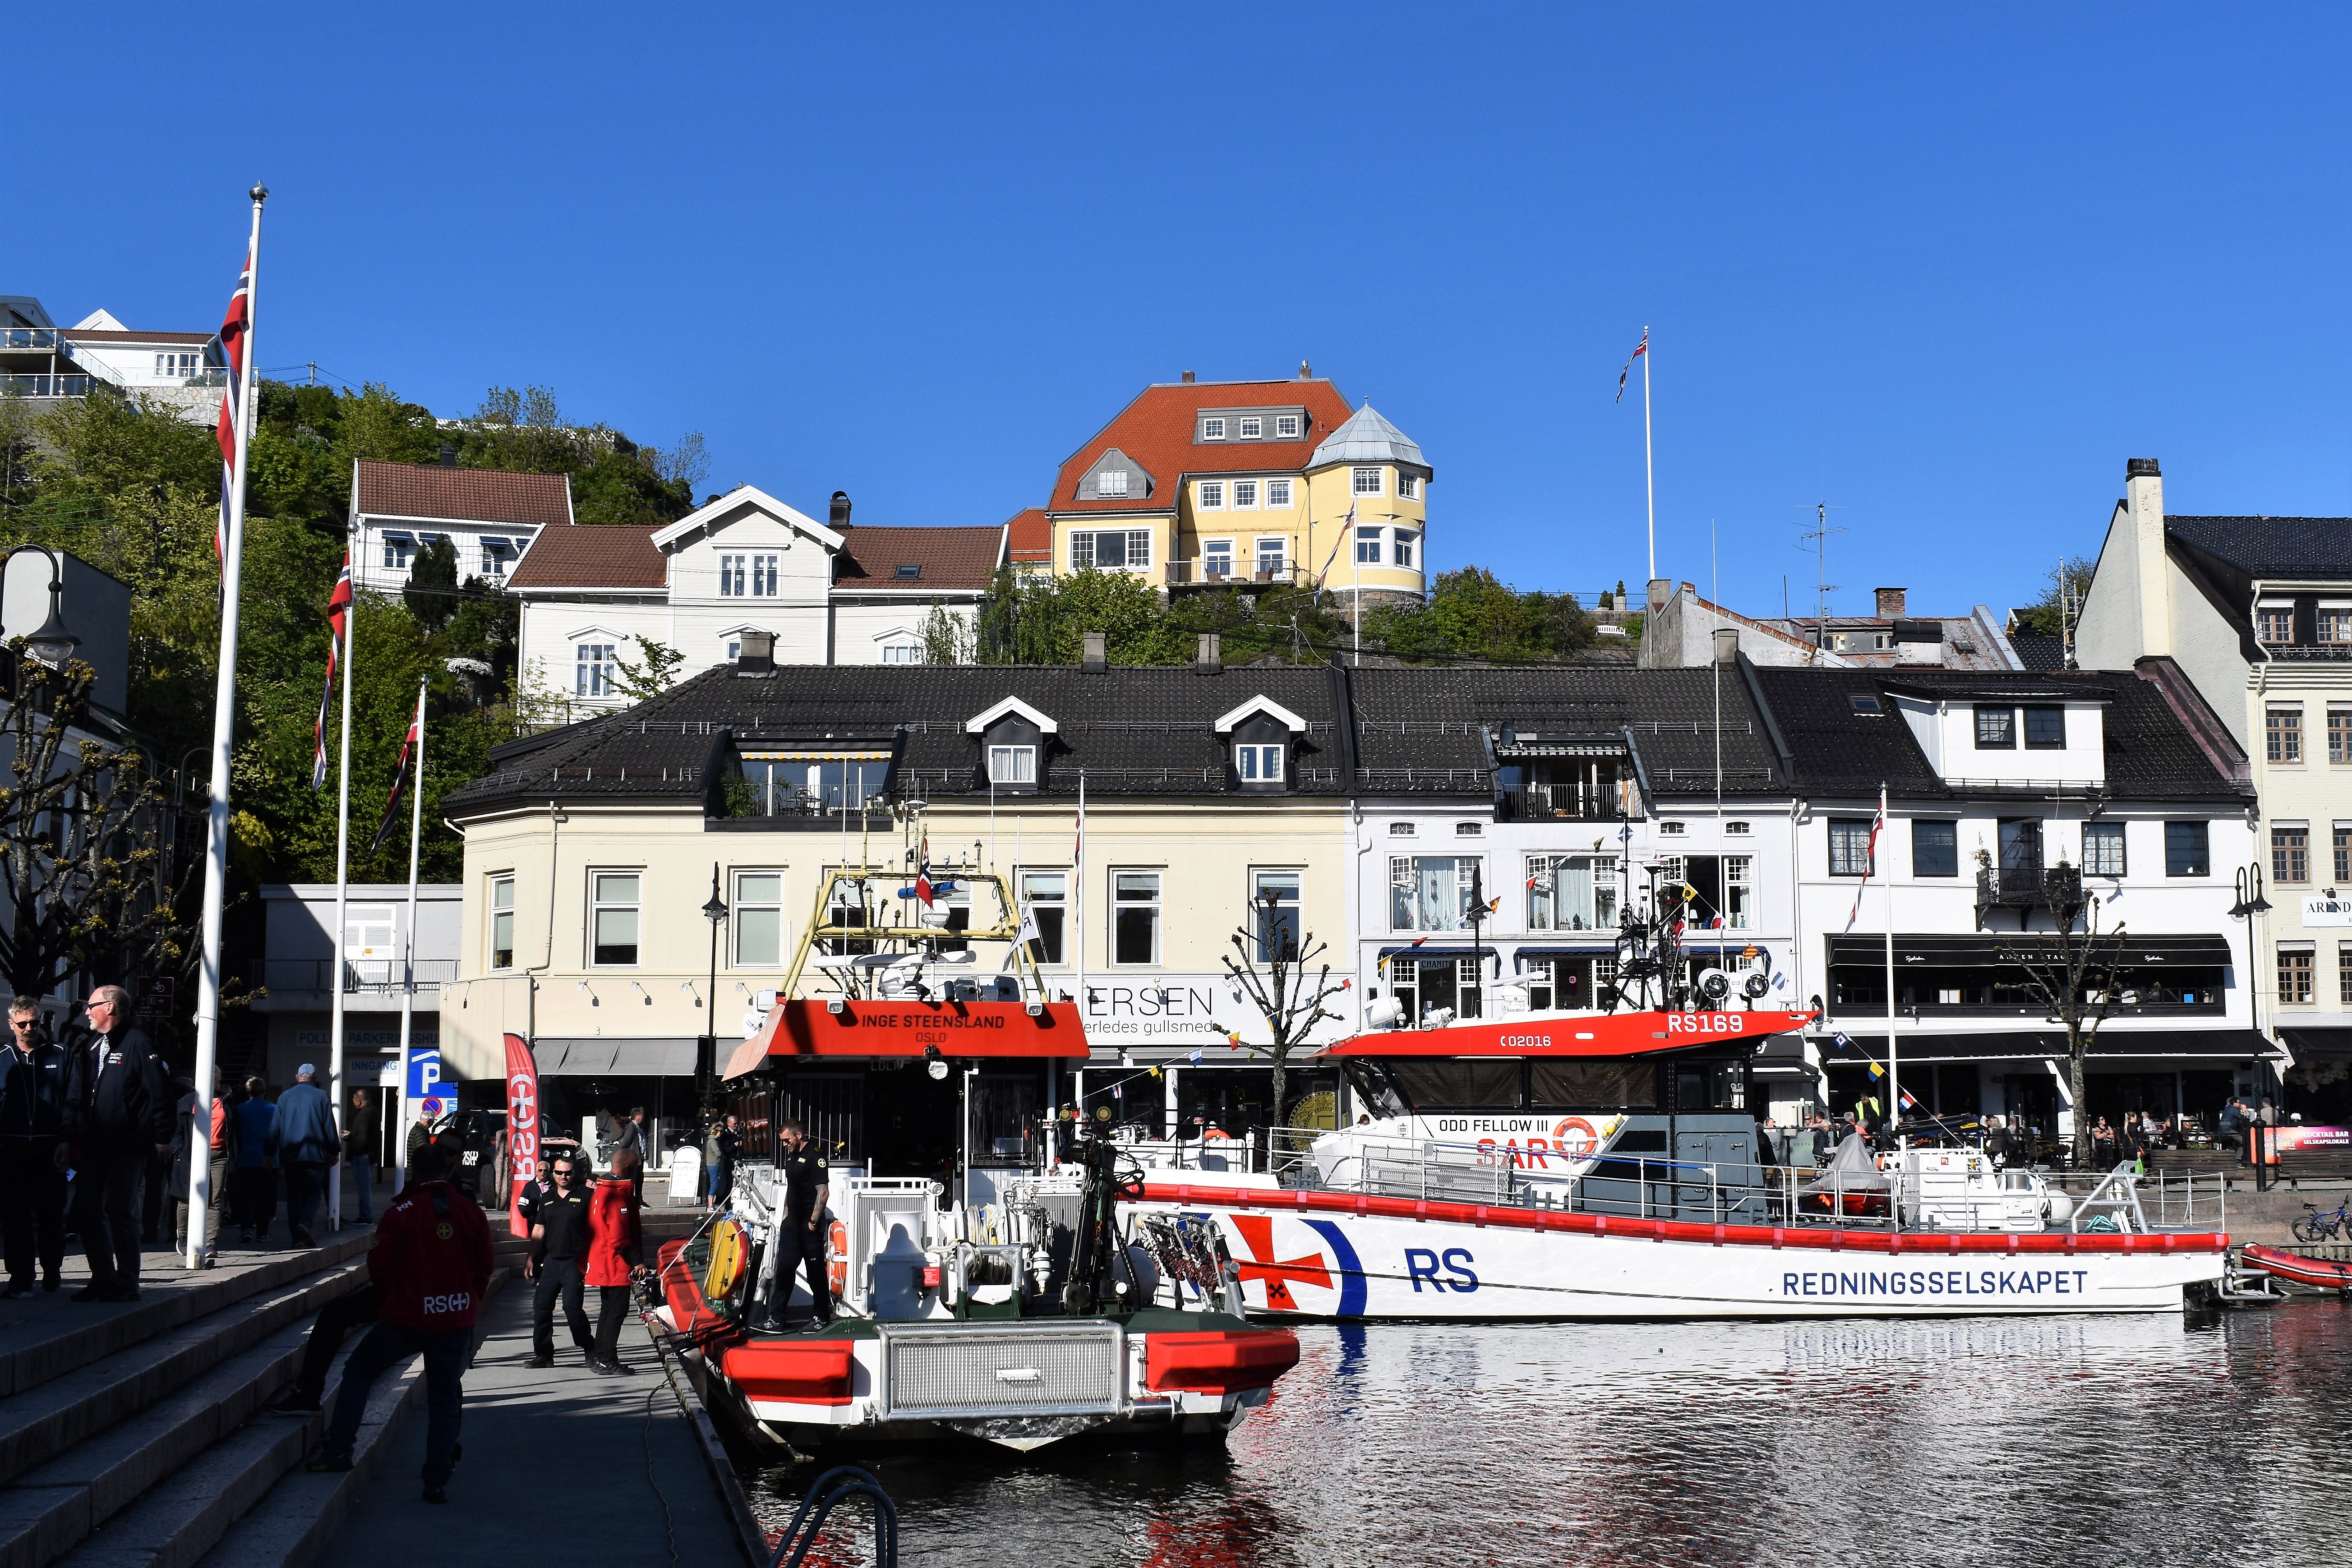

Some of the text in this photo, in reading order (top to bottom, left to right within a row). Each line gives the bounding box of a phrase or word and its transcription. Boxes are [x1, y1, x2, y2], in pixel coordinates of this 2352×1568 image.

[2307, 902, 2352, 913] AREND
[862, 1015, 1004, 1028] INGE STEENSLAND
[1084, 1019, 1213, 1036] erledes gullsmed
[1668, 1015, 1743, 1033] RS169
[915, 1032, 947, 1042] OSLO
[351, 1061, 397, 1070] INNGANG
[422, 1062, 440, 1094] P
[1439, 1120, 1467, 1131] ODD
[1474, 1120, 1532, 1132] FELLOW
[1477, 1138, 1549, 1169] SAR
[1404, 1248, 1479, 1293] RS
[1784, 1272, 2088, 1295] REDNINGSSELSKAPET
